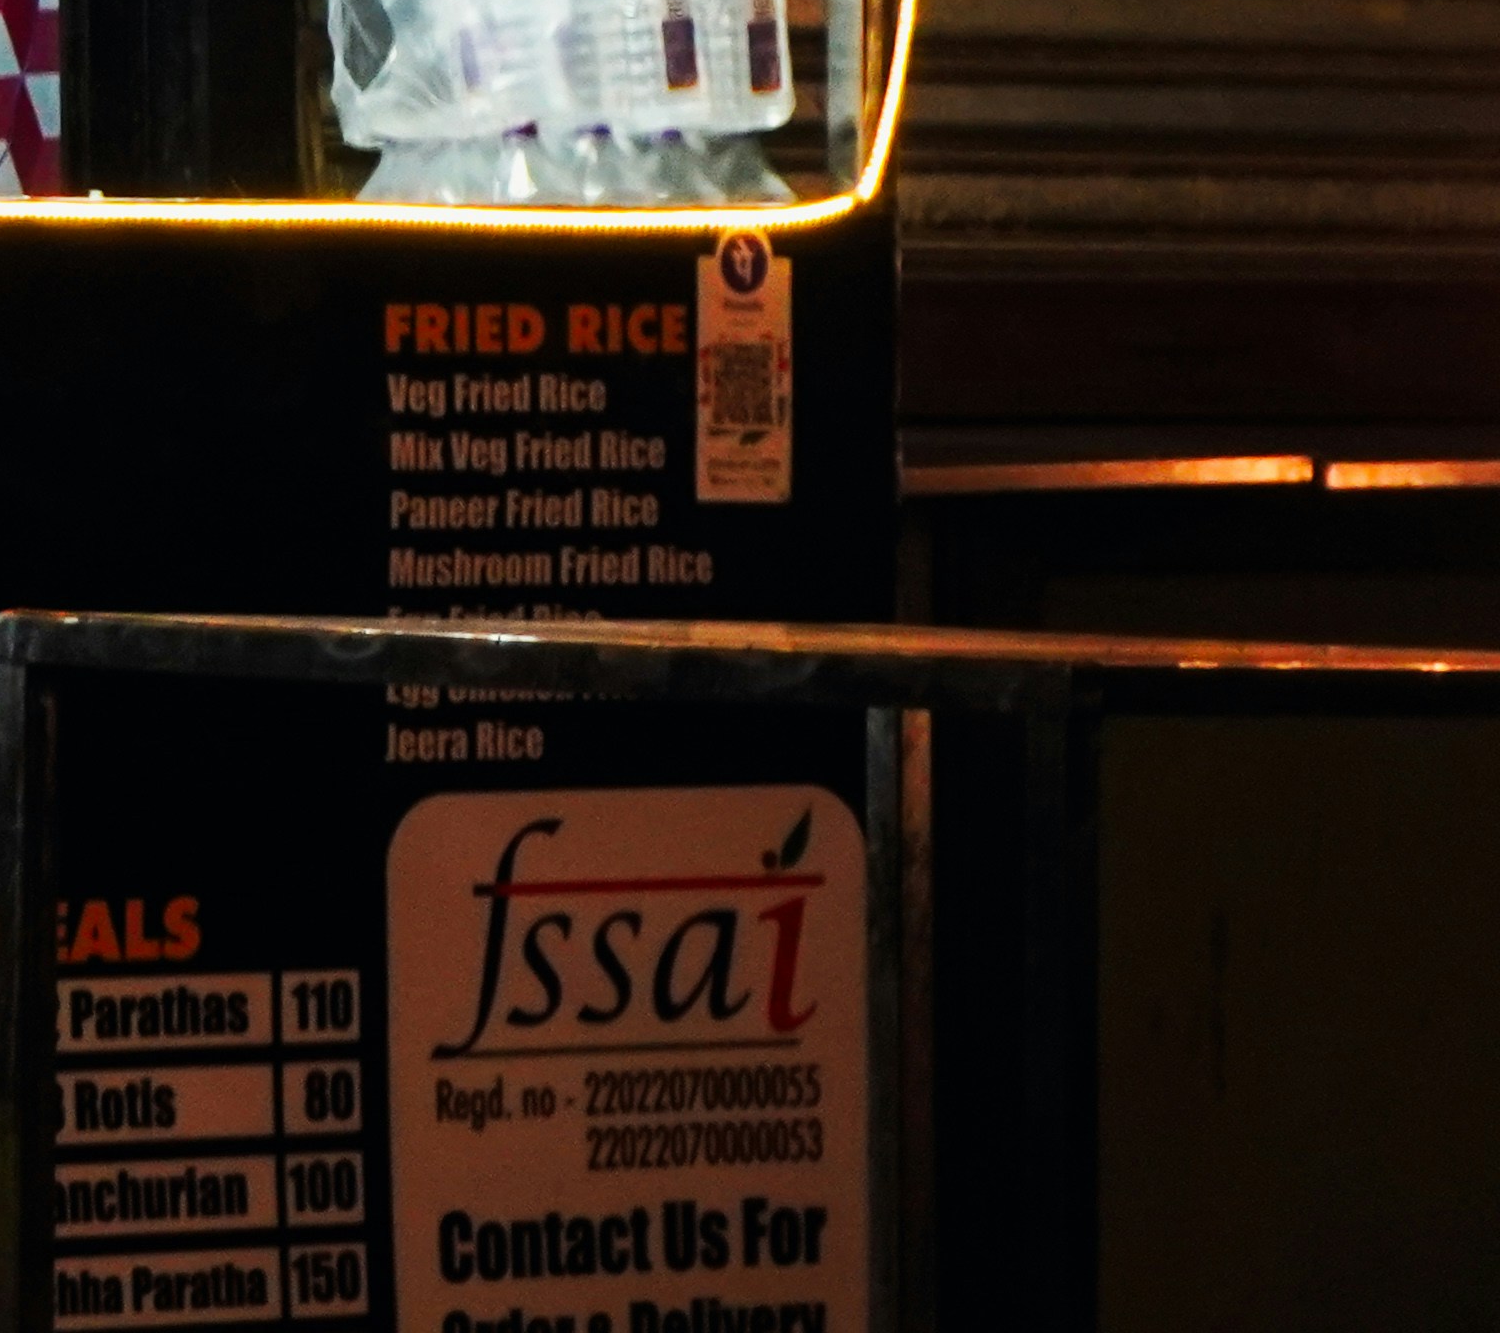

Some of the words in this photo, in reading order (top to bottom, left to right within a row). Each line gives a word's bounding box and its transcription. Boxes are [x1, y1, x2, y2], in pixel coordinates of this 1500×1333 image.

[383, 302, 547, 355] FRIED
[567, 302, 690, 355] RICE
[387, 373, 447, 418] Veg
[453, 372, 532, 413] Fried
[538, 372, 608, 414] Rice
[389, 431, 444, 472] Mix
[450, 431, 508, 477] Veg
[514, 429, 593, 471] Fried
[598, 429, 667, 471] Rice
[388, 489, 499, 532] Paneer
[505, 487, 585, 530] Fried
[590, 487, 661, 529] Rice
[387, 546, 553, 589] Mushroom
[558, 544, 642, 587] Fried
[647, 543, 716, 587] Rice
[384, 720, 470, 764] Jeera
[474, 718, 546, 763] Rice
[431, 813, 823, 1060] fssai
[70, 987, 249, 1039] Parathas
[292, 979, 352, 1032] 110
[75, 1078, 175, 1131] Rotis
[304, 1070, 355, 1122] 80
[436, 1076, 512, 1130] Regd.
[522, 1085, 555, 1118] no
[288, 1160, 358, 1213] 100
[439, 1205, 653, 1284] Contact
[662, 1199, 731, 1271] Us
[743, 1196, 828, 1268] For
[131, 1263, 268, 1313] Paratha
[294, 1251, 360, 1304] 150
